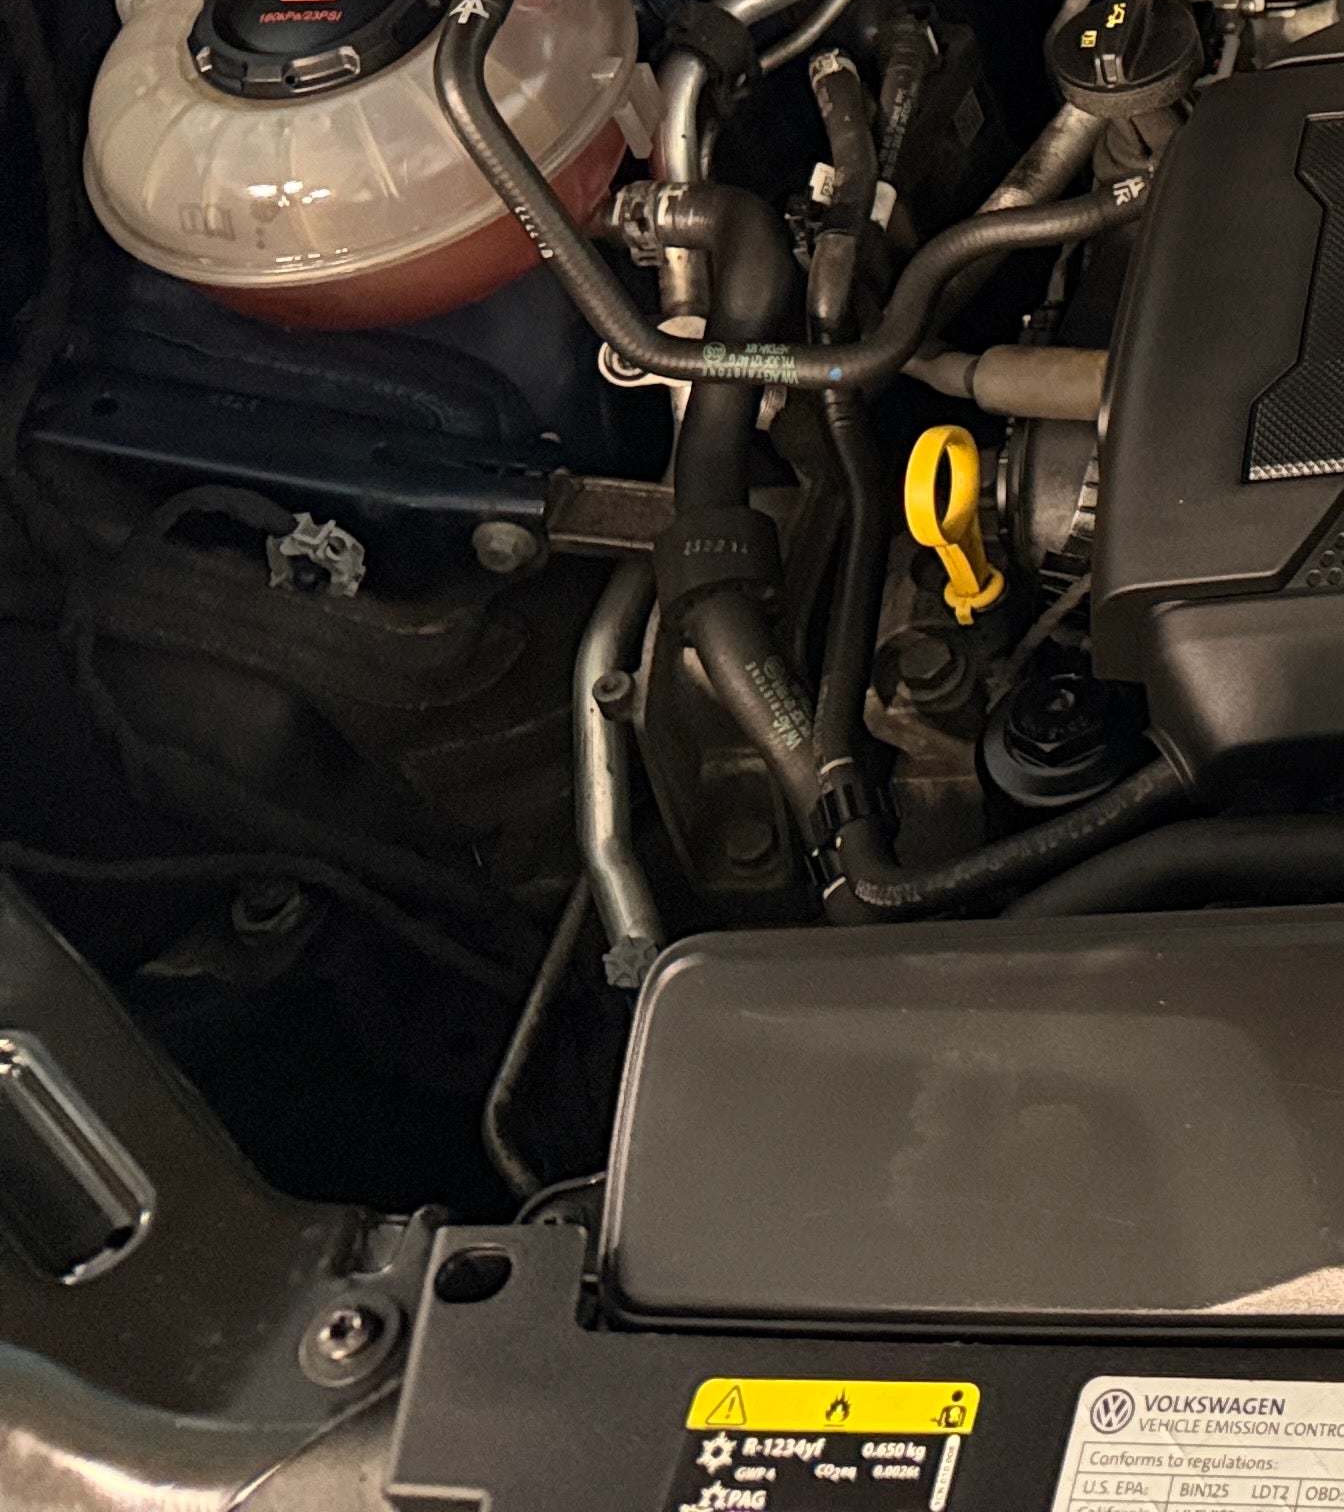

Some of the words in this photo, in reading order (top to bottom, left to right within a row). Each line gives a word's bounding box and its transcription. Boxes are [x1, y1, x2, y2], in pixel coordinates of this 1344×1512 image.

[1144, 1394, 1286, 1416] VOLKSWAGEN
[1138, 1417, 1202, 1436] VEHICLE
[1204, 1419, 1281, 1436] EMISSION
[742, 1437, 827, 1462] R-1234yf
[861, 1441, 906, 1460] 0.650
[906, 1442, 927, 1464] kg
[1089, 1450, 1164, 1473] Conforms
[1167, 1450, 1187, 1469] to
[1186, 1452, 1279, 1477] regulations:
[727, 1489, 767, 1510] PAG
[1114, 1480, 1150, 1497] EPA:
[1178, 1481, 1230, 1499] BIN125
[1250, 1483, 1290, 1504] LDT2
